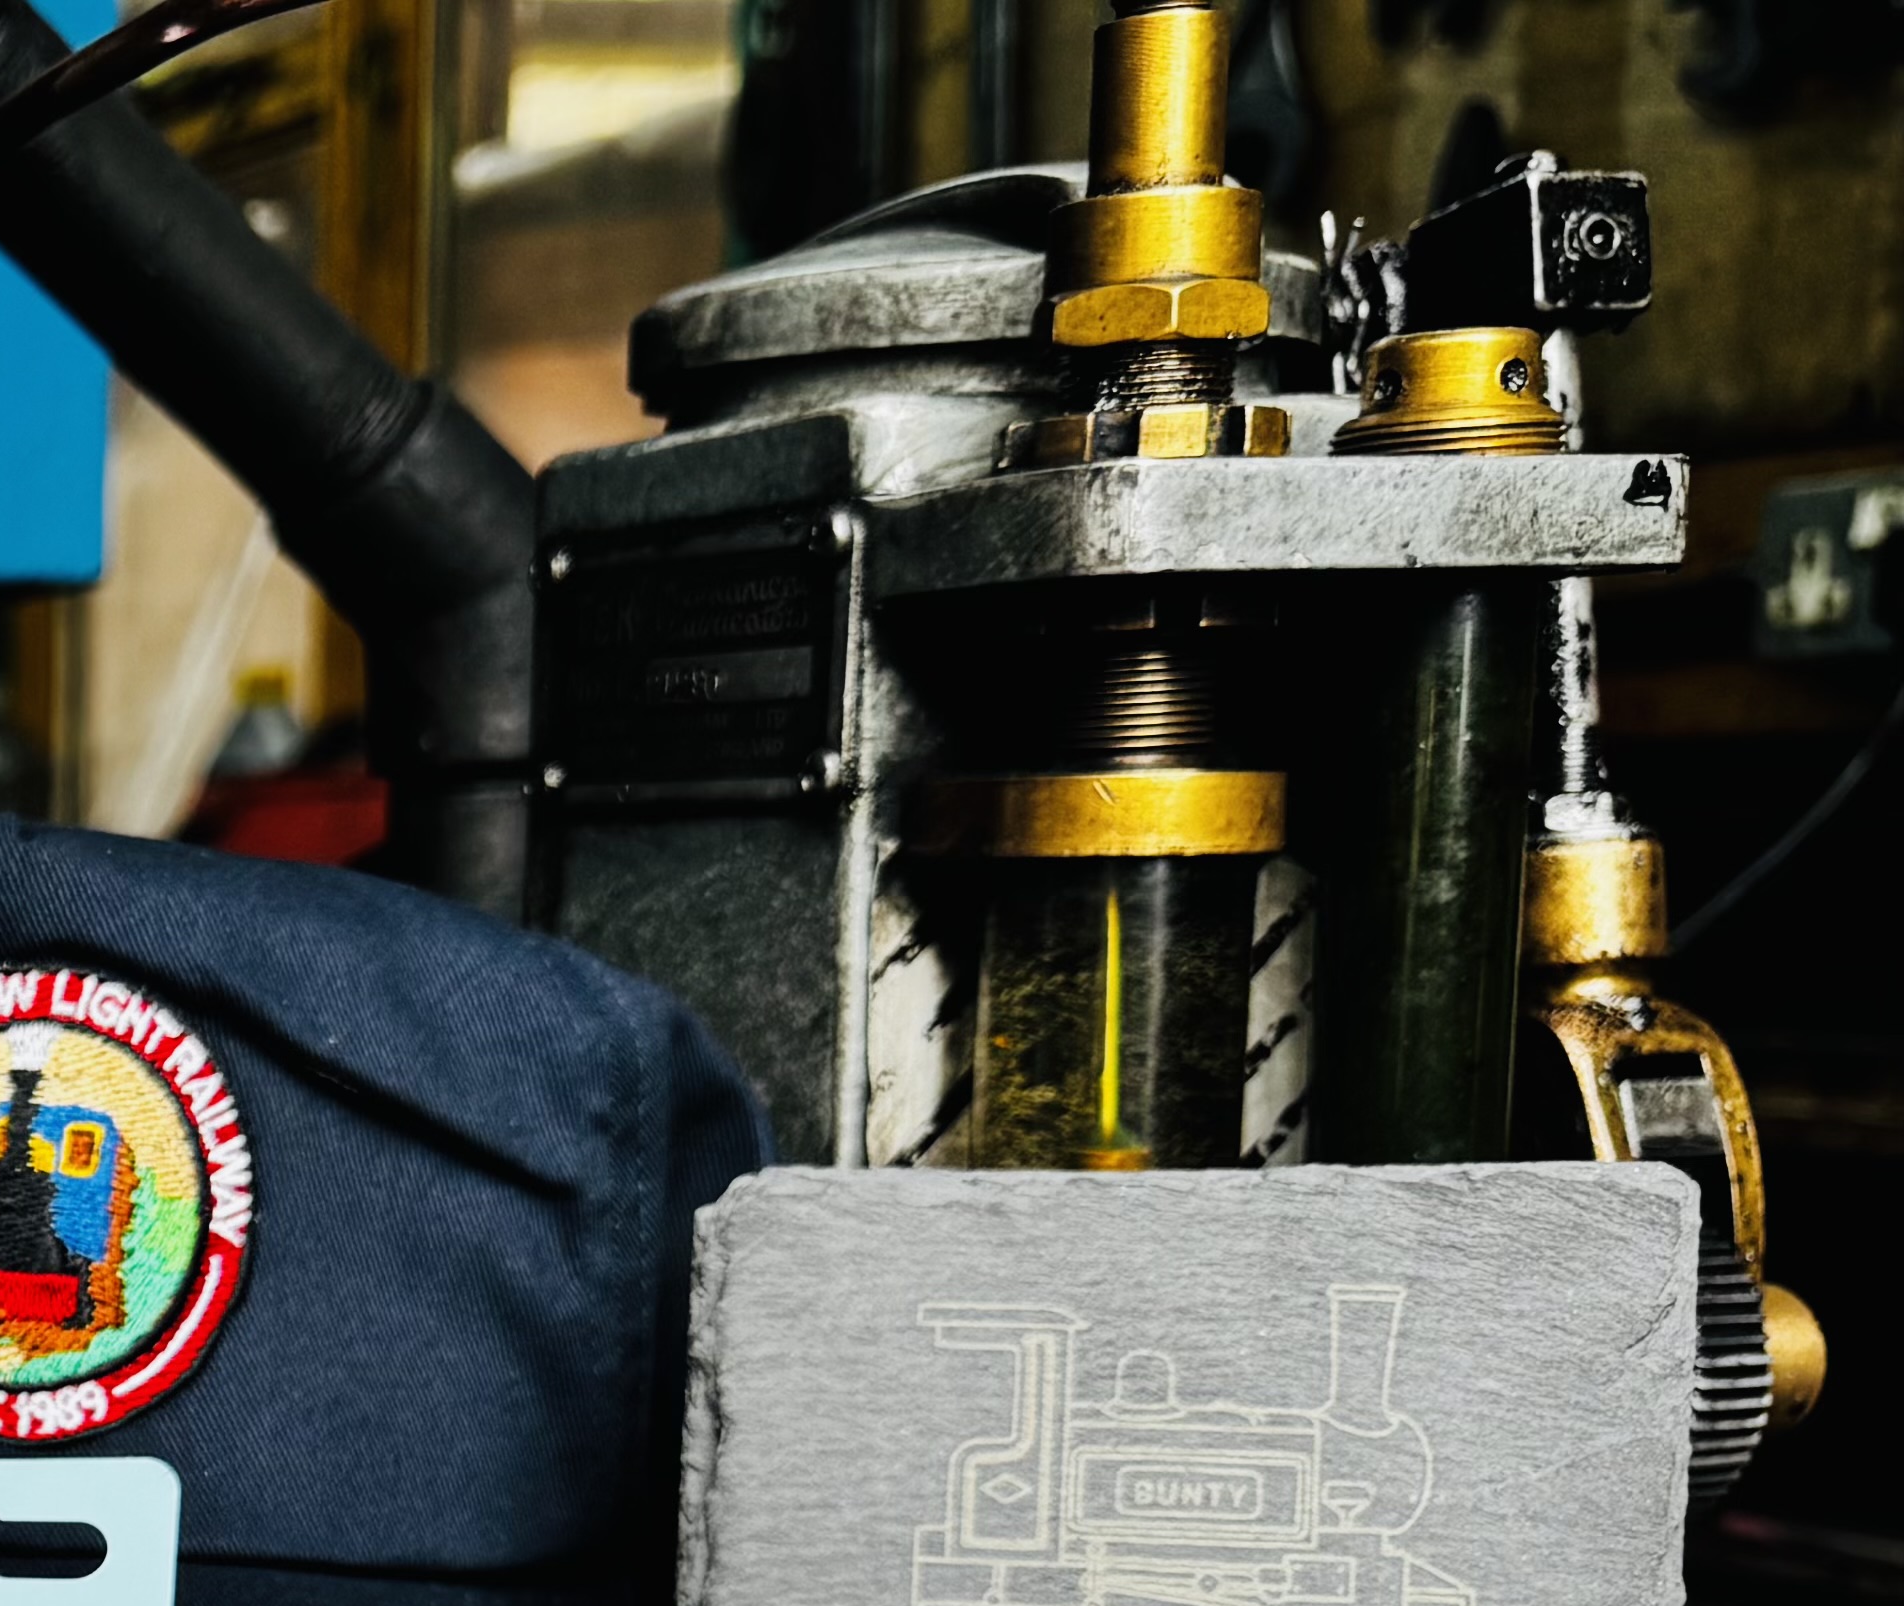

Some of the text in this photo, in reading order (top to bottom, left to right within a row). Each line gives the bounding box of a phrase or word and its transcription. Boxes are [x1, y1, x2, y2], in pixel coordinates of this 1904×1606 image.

[50, 969, 185, 1055] LIGHT
[163, 1032, 254, 1248] RAILWAY
[15, 1385, 109, 1437] 1989
[1132, 1475, 1251, 1510] BUNTY
